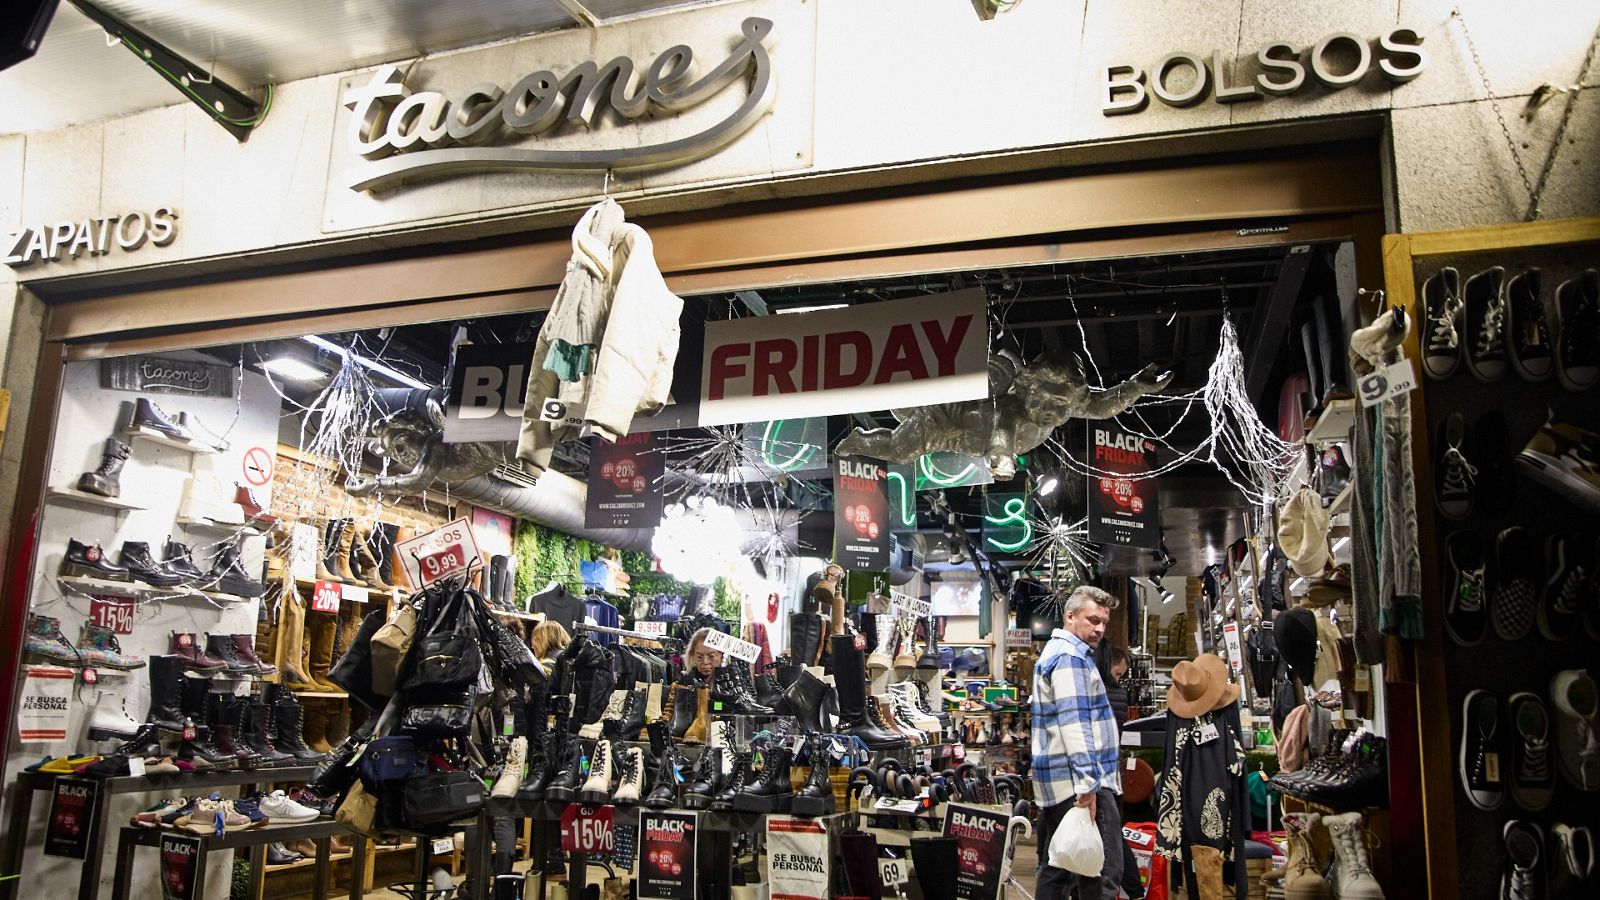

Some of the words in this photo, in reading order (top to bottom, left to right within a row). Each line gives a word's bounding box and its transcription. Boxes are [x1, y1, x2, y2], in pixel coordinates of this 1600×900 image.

[1102, 28, 1426, 116] BOLSOS
[344, 16, 773, 190] tacones
[3, 207, 177, 265] ZAPATOS
[708, 314, 974, 401] FRIDAY
[1095, 429, 1145, 453] BLACK
[1095, 445, 1145, 465] FRIDAY
[616, 465, 635, 478] 20%
[839, 459, 879, 481] BLACK
[840, 476, 878, 494] FRIDAY
[1115, 482, 1132, 497] 20%
[426, 553, 457, 576] 9,99
[313, 589, 340, 611] -20%
[893, 593, 906, 606] LAST
[905, 598, 912, 608] IN
[911, 600, 931, 615] LONDON
[707, 630, 725, 647] LAST
[723, 636, 733, 649] IN
[731, 639, 759, 661] LONDON
[23, 702, 68, 711] PERSONAL
[37, 696, 67, 704] BUSCA
[59, 784, 88, 798] BLACK
[580, 807, 594, 816] GD
[646, 818, 685, 833] BLACK
[952, 812, 997, 832] BLACK
[561, 818, 613, 851] -15%
[646, 829, 684, 843] FRIDAY
[950, 824, 994, 842] FRIDAY
[164, 841, 192, 856] BLACK
[962, 850, 978, 862] 20%
[660, 854, 673, 864] 20%
[772, 861, 825, 873] PERSONAL
[774, 853, 787, 862] SE
[790, 854, 824, 866] BUSCA
